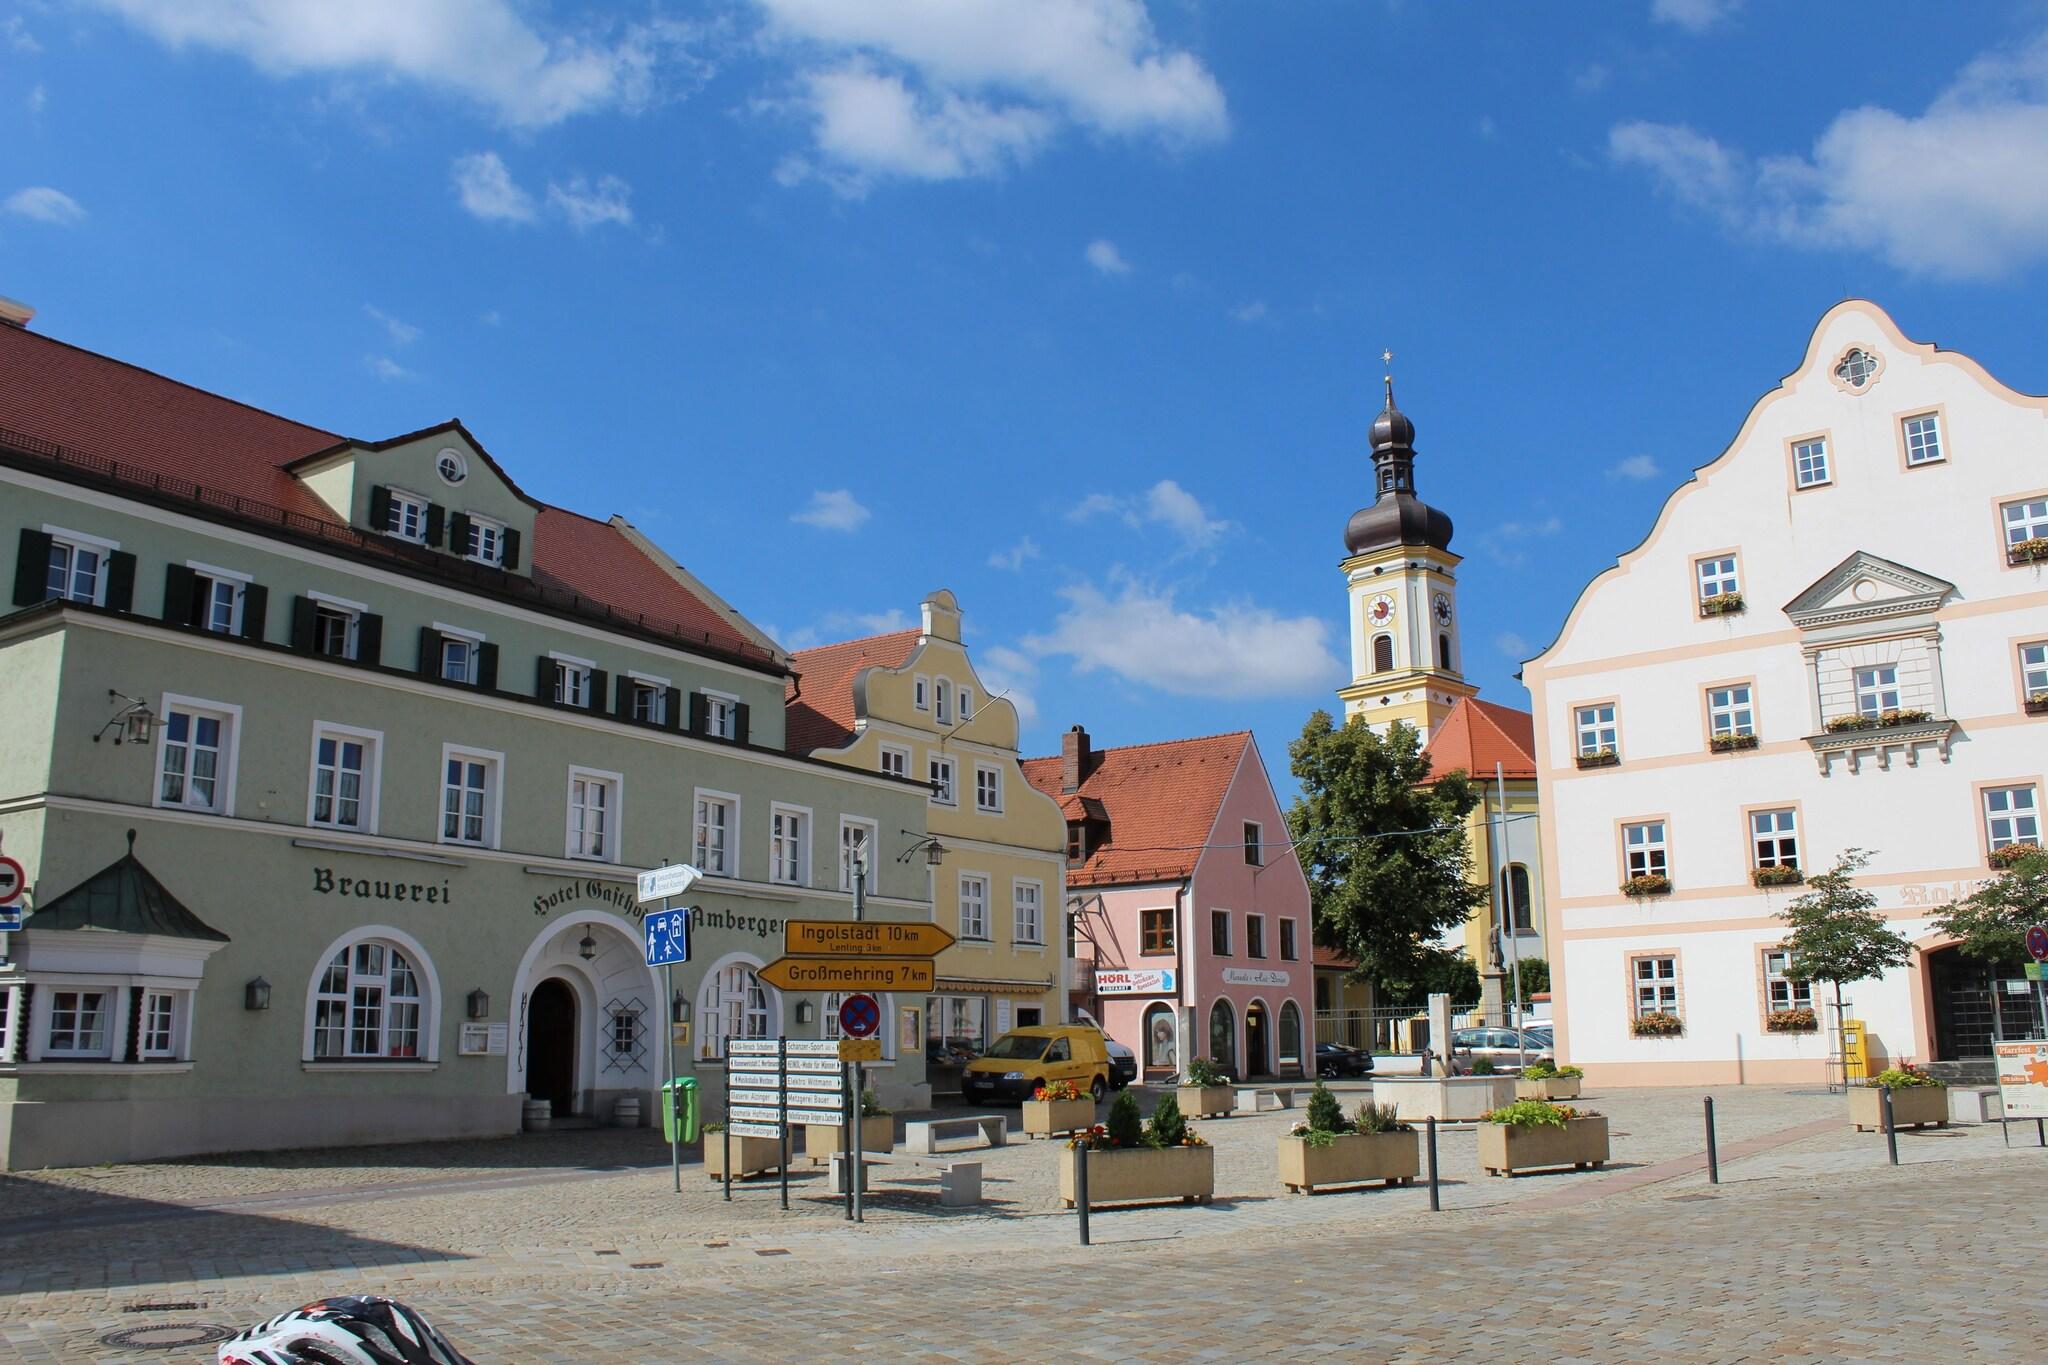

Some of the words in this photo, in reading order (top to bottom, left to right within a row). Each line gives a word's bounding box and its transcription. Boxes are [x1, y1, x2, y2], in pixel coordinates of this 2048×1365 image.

[313, 867, 450, 904] Brauerei
[533, 880, 581, 917] Hotel
[802, 925, 880, 943] Ingolstadt
[888, 926, 901, 940] 10
[904, 929, 919, 941] km
[830, 943, 863, 953] Lenting
[789, 966, 894, 983] Großmehring
[901, 967, 909, 981] 7
[912, 969, 927, 981] km
[1098, 973, 1131, 983] HÖRL
